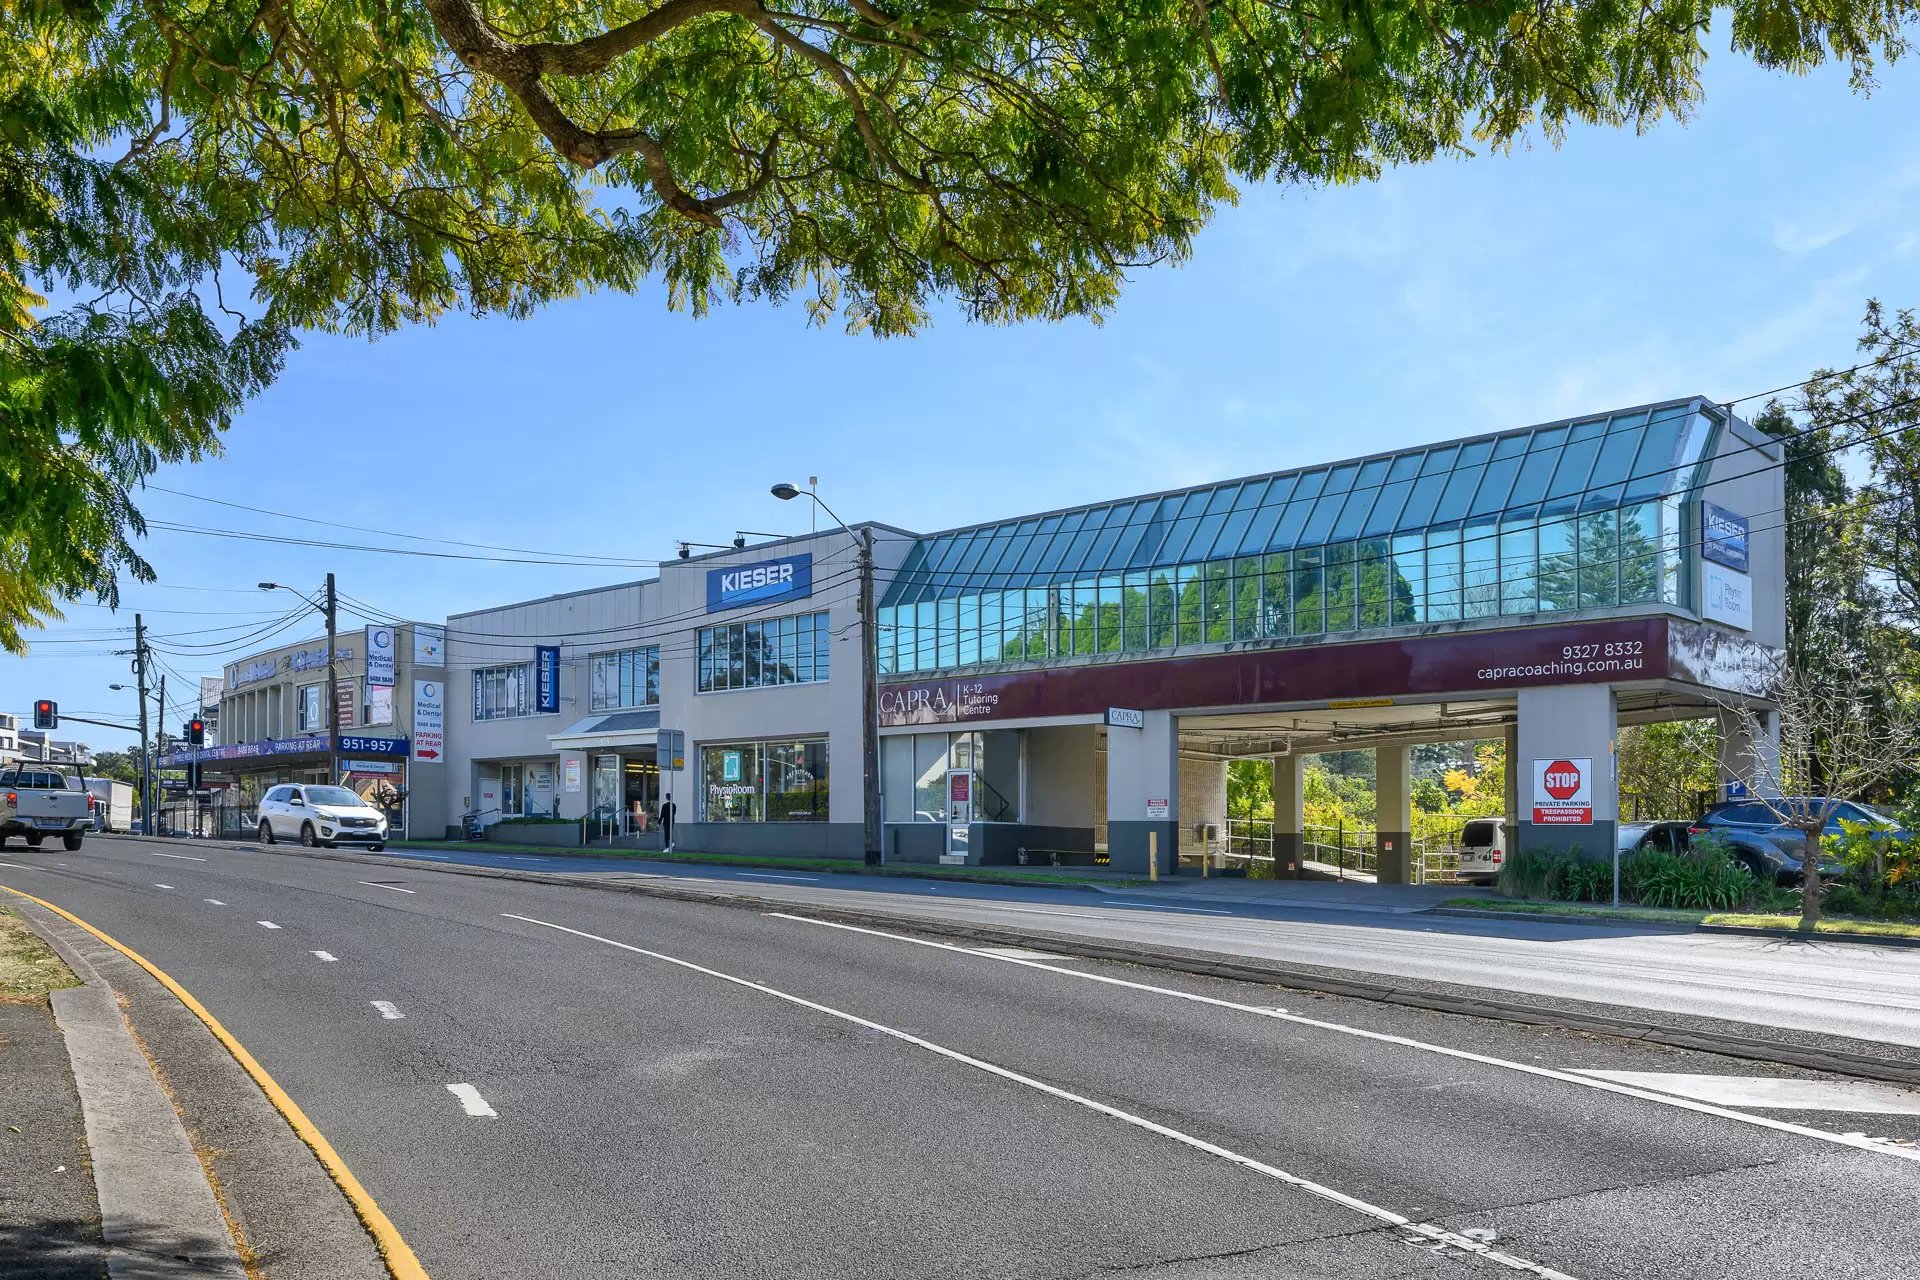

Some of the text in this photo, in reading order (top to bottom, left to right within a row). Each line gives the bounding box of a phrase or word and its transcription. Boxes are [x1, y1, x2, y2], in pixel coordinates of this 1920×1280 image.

[1708, 513, 1745, 541] KIESER
[722, 564, 793, 592] KIESER
[1724, 597, 1741, 613] Room
[1563, 641, 1643, 660] 9327 8332
[369, 654, 393, 662] Medical
[1477, 658, 1643, 681] capracoaching.com.au
[541, 650, 550, 708] KIESER
[963, 683, 983, 695] K-12
[417, 701, 441, 709] Medical
[880, 687, 952, 716] CAPRA
[963, 693, 998, 705] Tutoring
[423, 709, 442, 717] Dental
[963, 705, 991, 715] Centre
[1111, 710, 1140, 724] CAPRA
[415, 731, 442, 740] PARKING
[275, 739, 321, 752] PARKING AT REAR
[343, 738, 394, 752] 951-957
[1546, 772, 1579, 788] STOP
[1732, 780, 1740, 794] P
[709, 784, 755, 796] PhysioRoom
